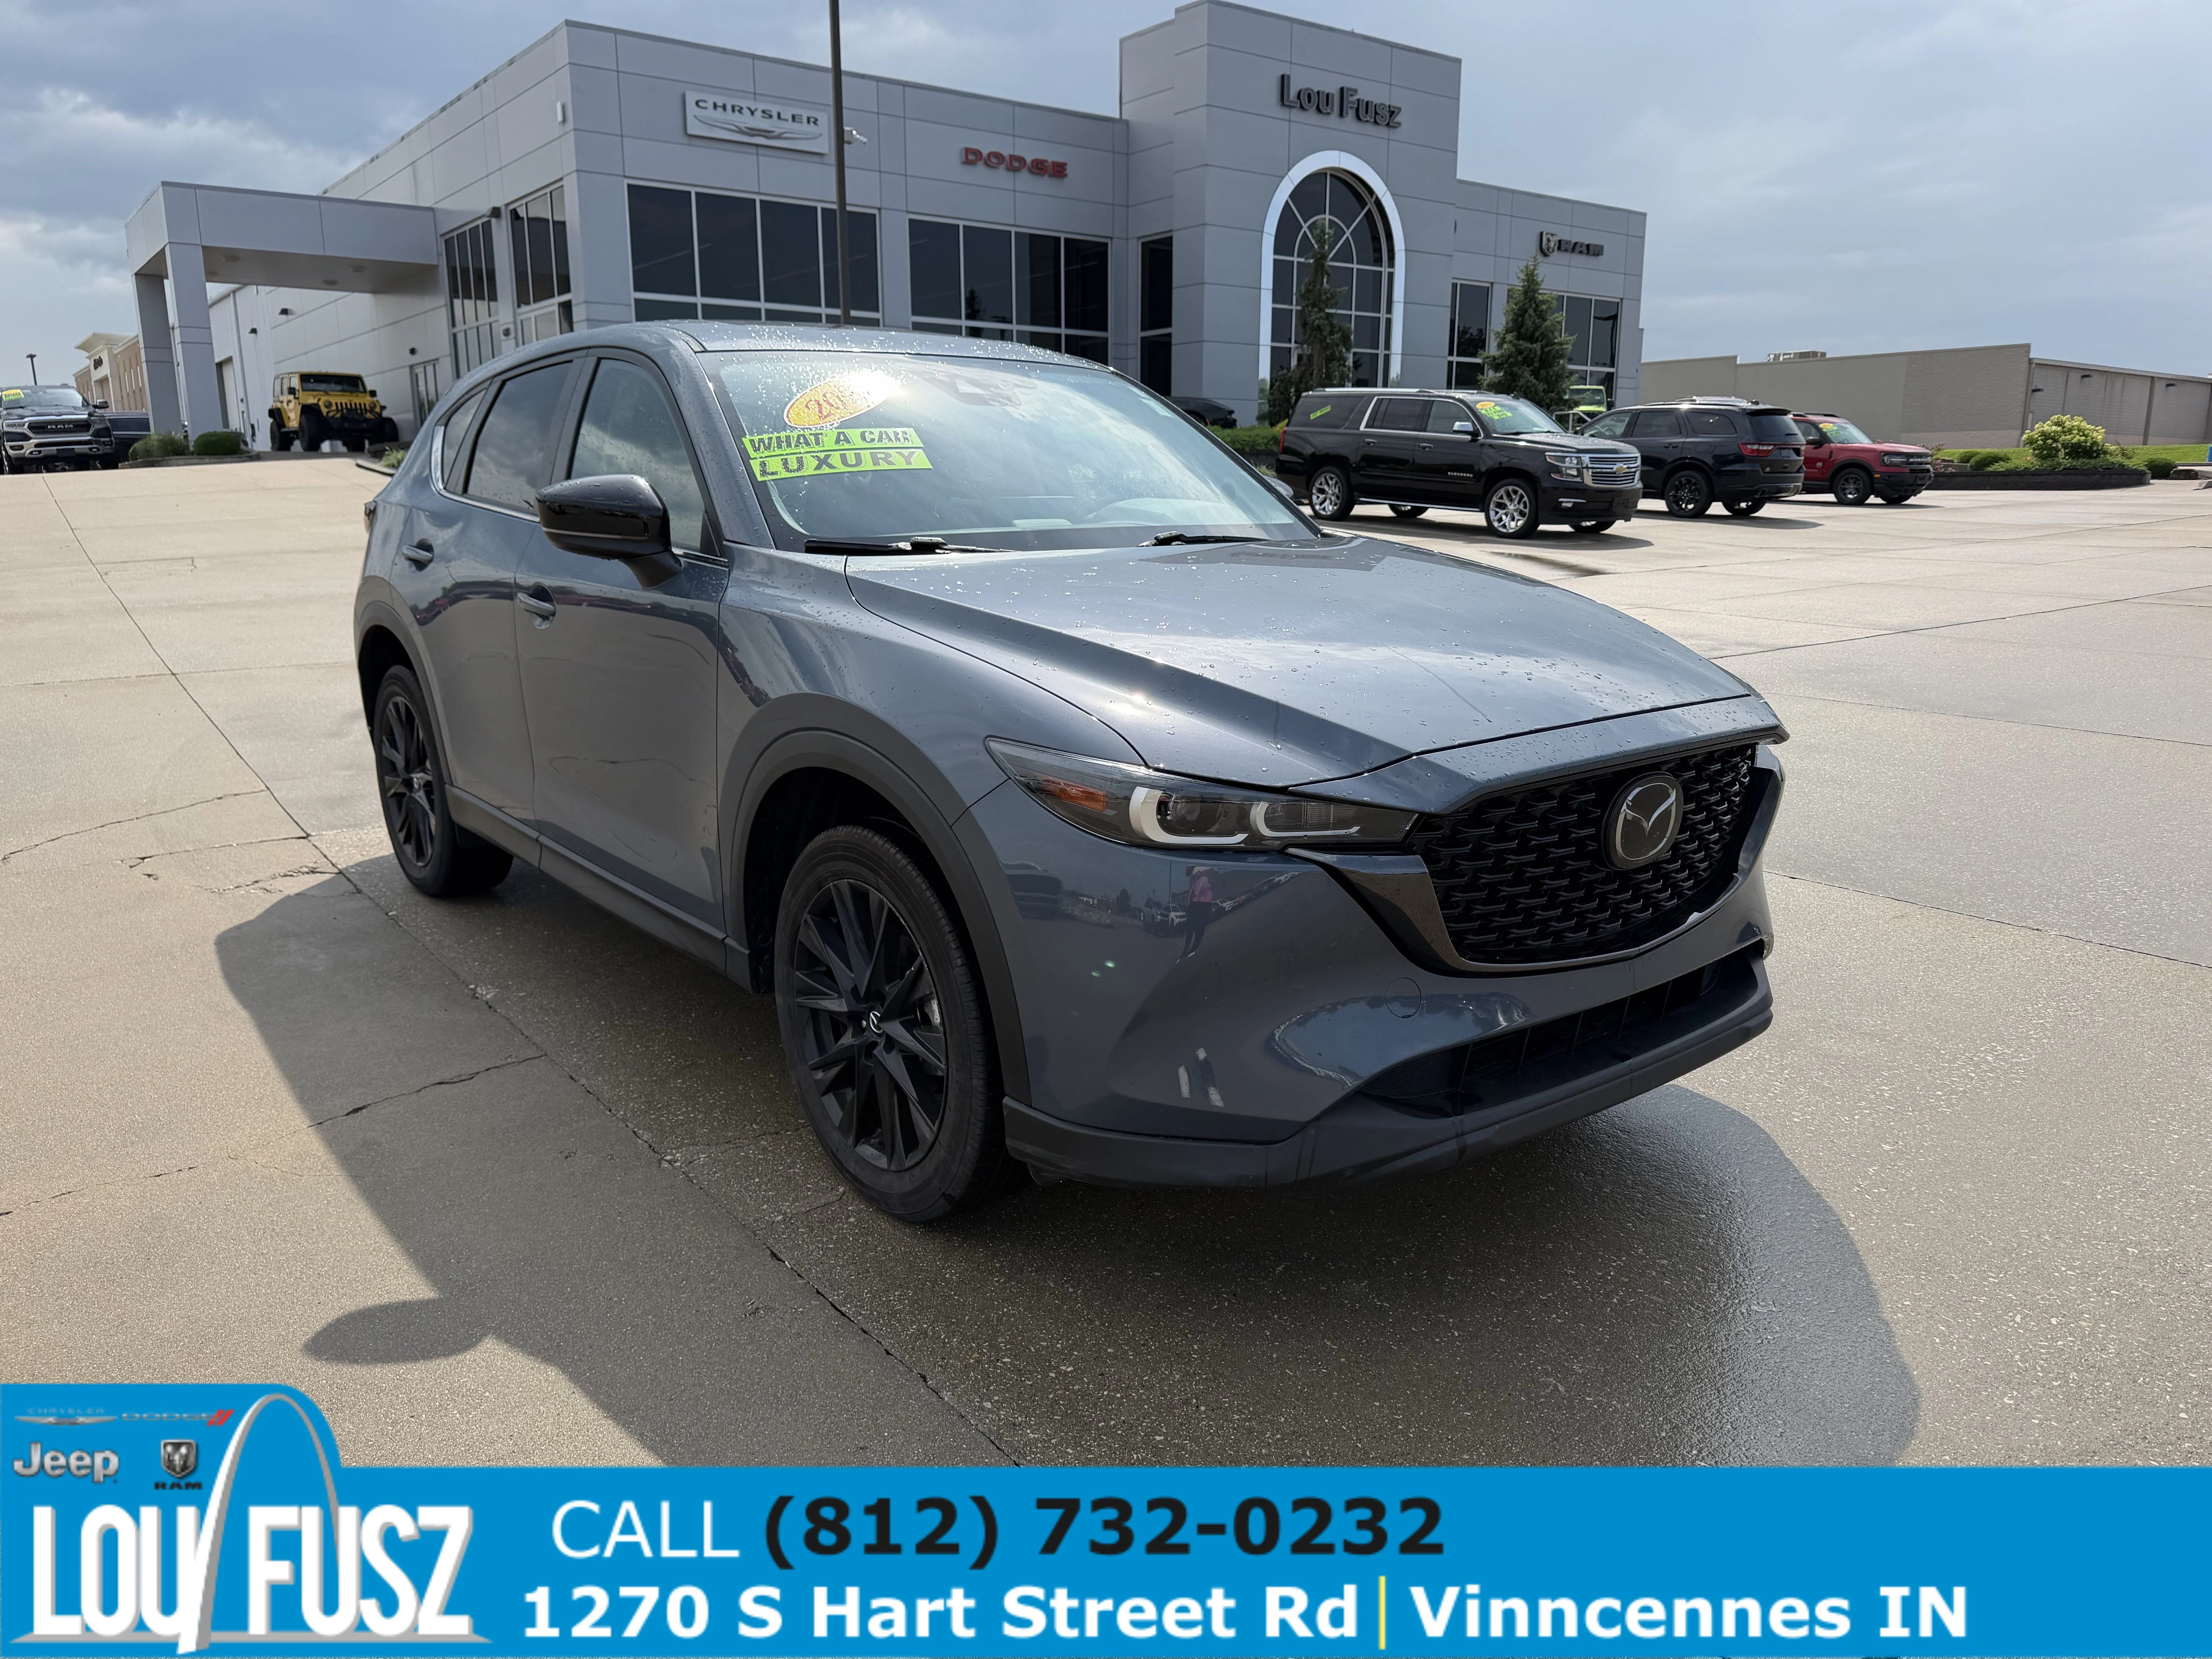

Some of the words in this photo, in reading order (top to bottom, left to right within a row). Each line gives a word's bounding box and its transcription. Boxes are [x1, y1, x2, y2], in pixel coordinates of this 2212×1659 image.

[695, 99, 819, 126] CHRYSLER
[1281, 73, 1334, 114] Lou
[1340, 86, 1402, 127] Fusz
[962, 146, 1068, 178] DODGE
[1558, 239, 1604, 256] RAM
[749, 432, 824, 453] WHAT
[834, 431, 852, 445] A
[860, 429, 910, 444] CAR
[759, 451, 917, 477] LUXURY
